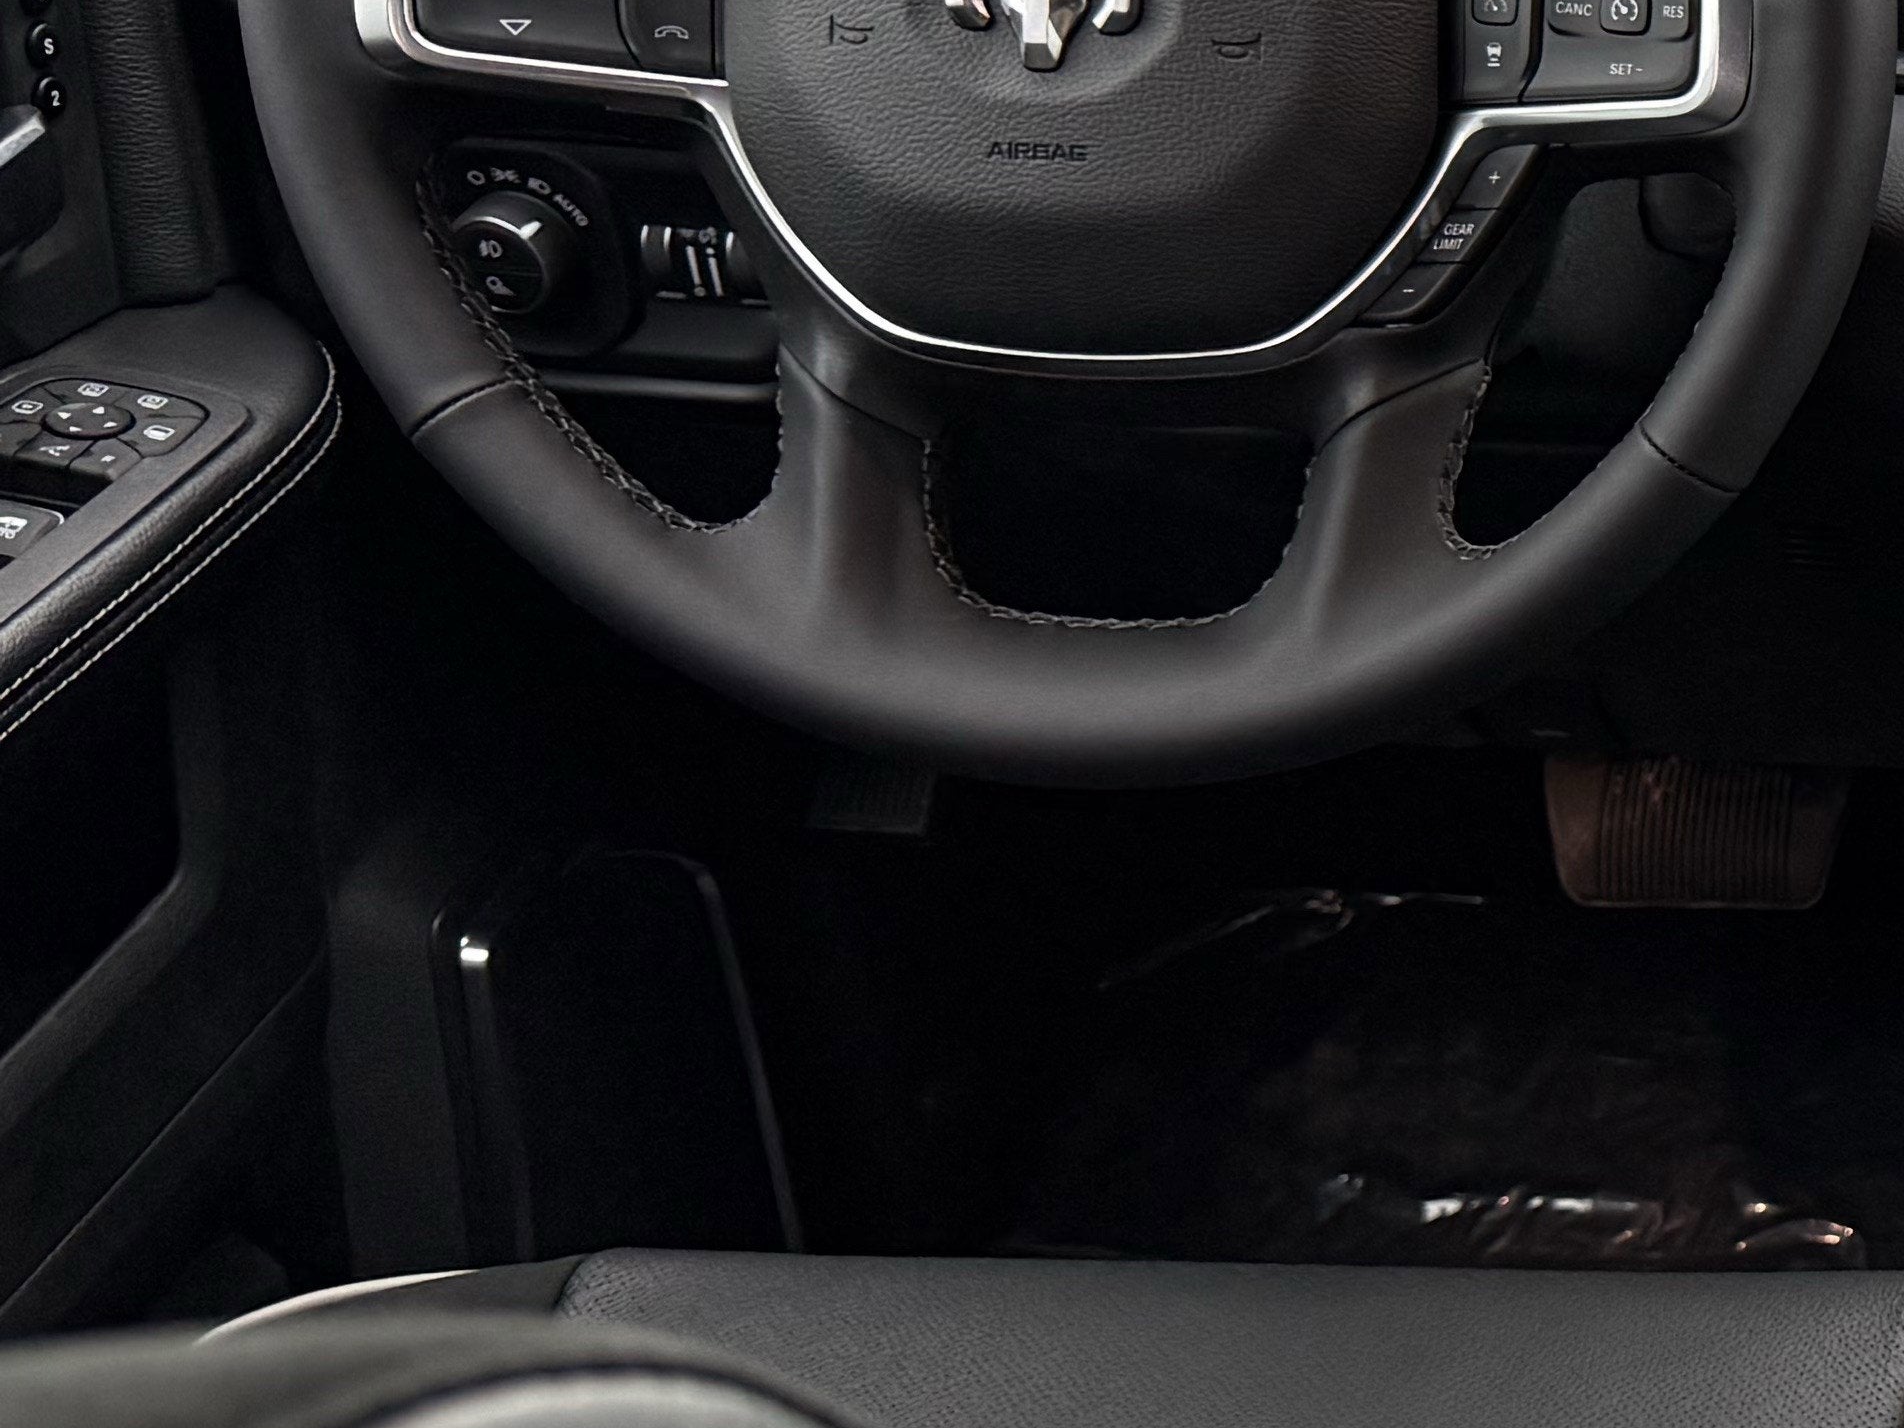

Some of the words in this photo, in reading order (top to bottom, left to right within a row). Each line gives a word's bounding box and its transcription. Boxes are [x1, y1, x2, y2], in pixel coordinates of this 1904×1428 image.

[1555, 1, 1593, 17] CANC
[1663, 5, 1684, 18] RES
[51, 89, 60, 106] 2
[987, 142, 1088, 162] AIRBAG
[553, 194, 589, 227] AUTO
[1444, 224, 1475, 236] GEAR
[1433, 239, 1464, 250] LIMIT
